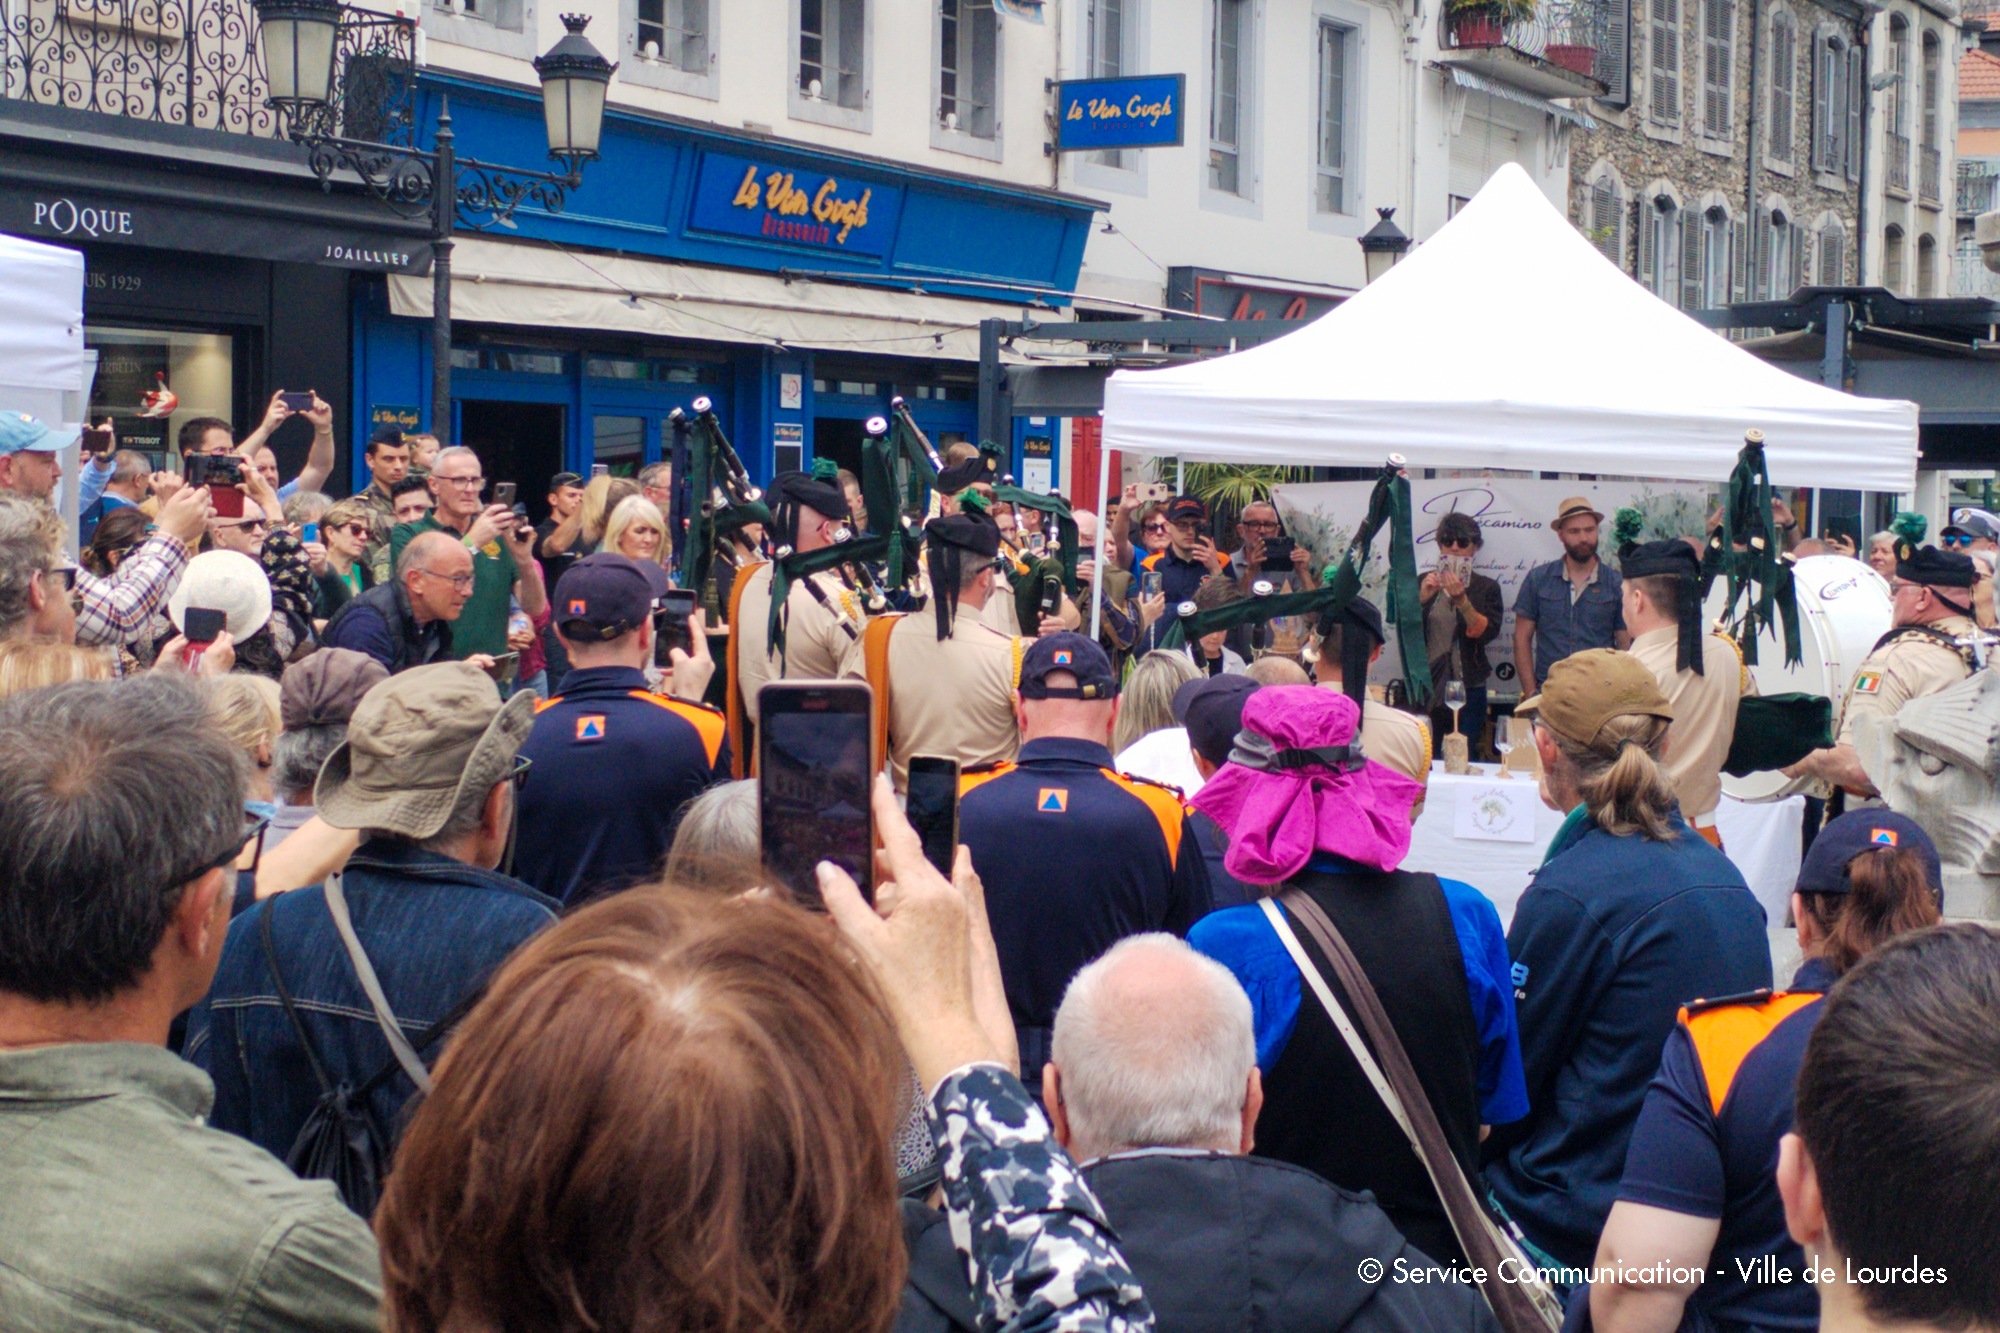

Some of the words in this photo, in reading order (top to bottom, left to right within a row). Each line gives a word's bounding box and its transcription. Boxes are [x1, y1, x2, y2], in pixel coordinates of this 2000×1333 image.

[1066, 98, 1083, 121] Le
[1087, 98, 1121, 119] Van
[1126, 94, 1172, 127] Gogh
[732, 165, 761, 209] Le
[766, 171, 809, 216] Van
[812, 178, 872, 245] Gogh
[325, 245, 409, 266] JOAILLIER
[85, 272, 106, 288] UIS
[111, 275, 142, 290] 1929
[99, 361, 141, 374] ERBELIN
[134, 436, 161, 445] TISSOT
